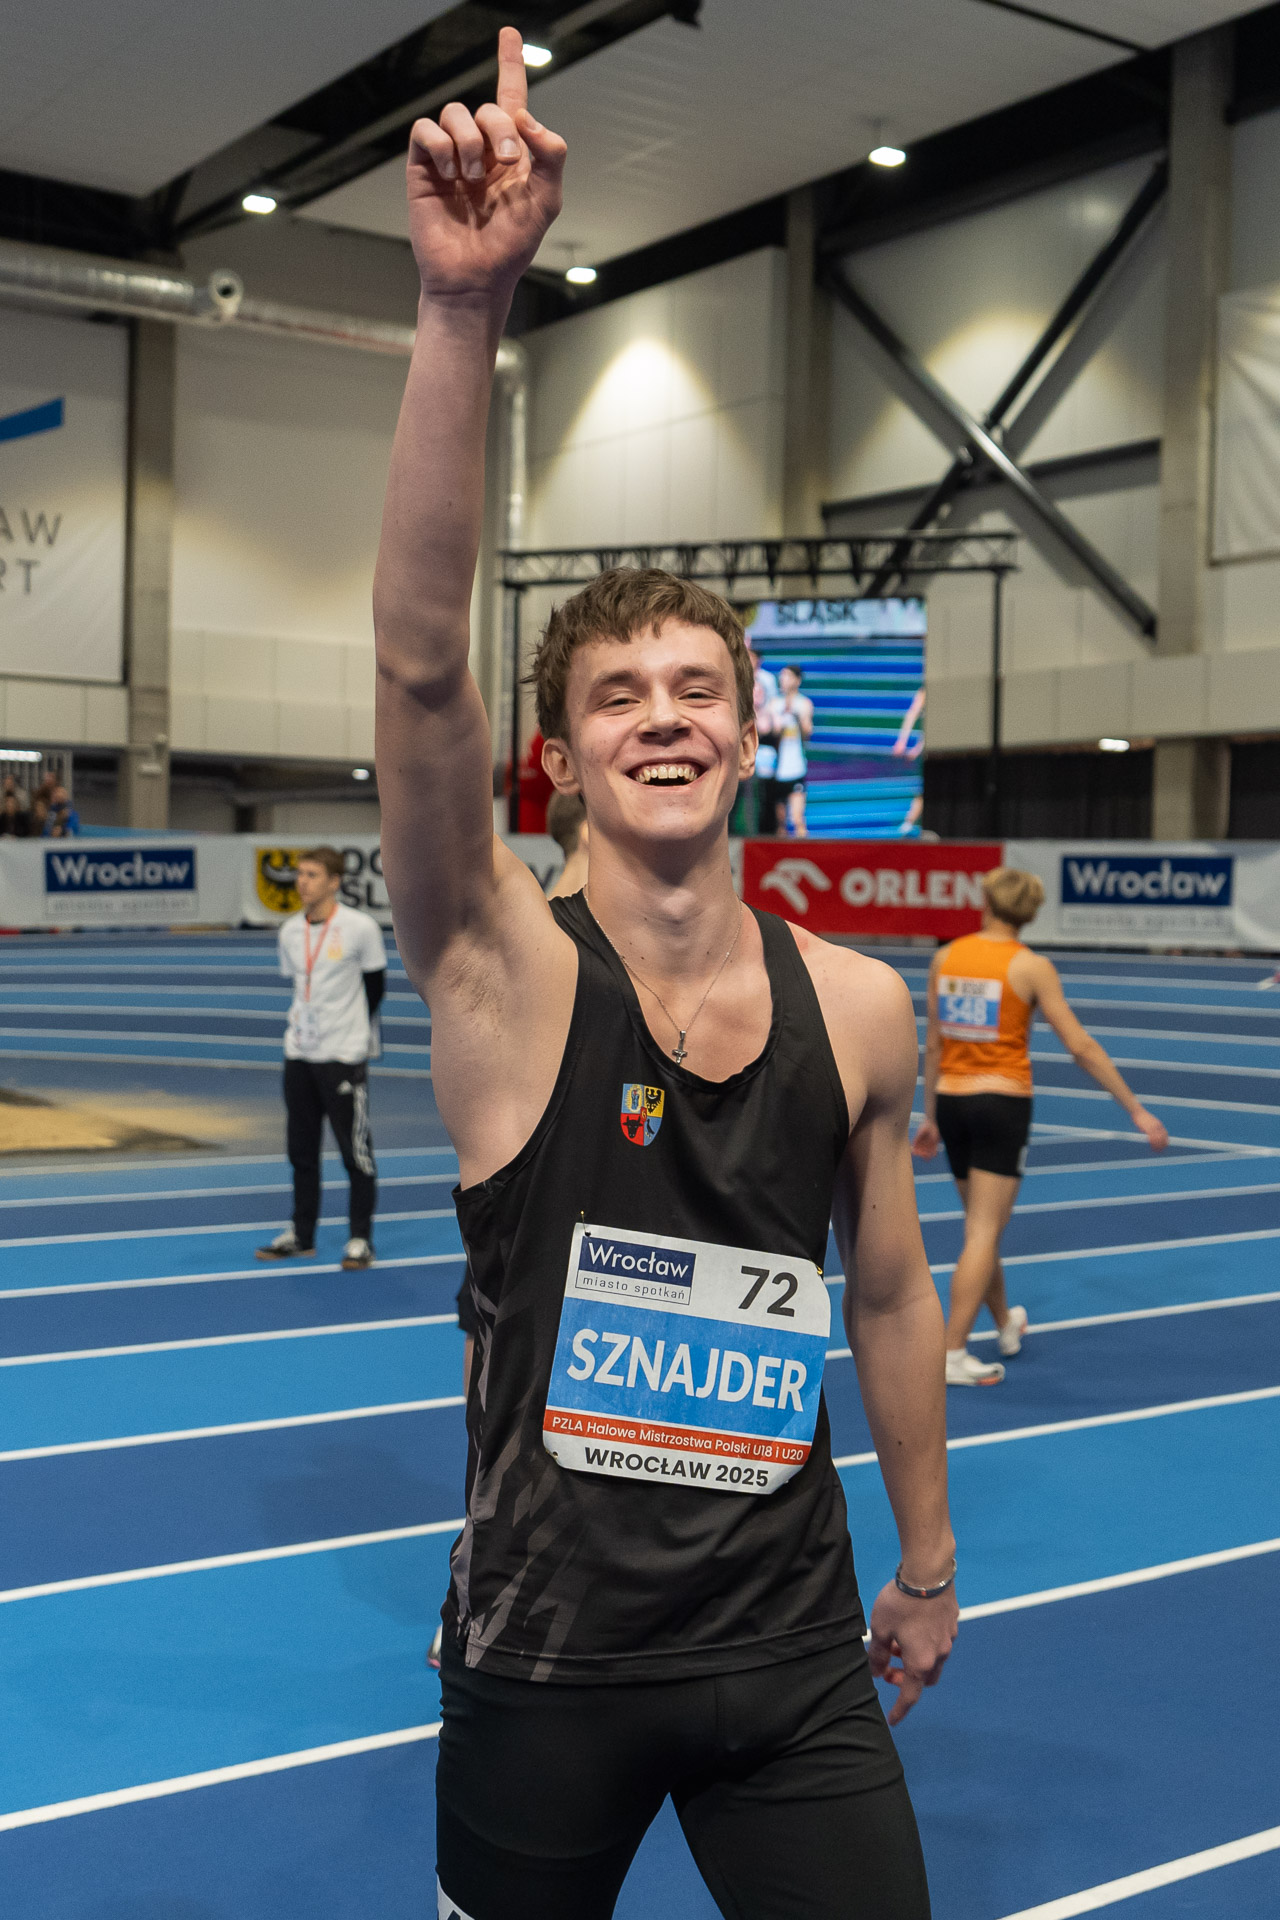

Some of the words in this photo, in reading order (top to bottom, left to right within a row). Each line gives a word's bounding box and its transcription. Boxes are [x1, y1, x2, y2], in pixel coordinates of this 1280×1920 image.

[840, 868, 986, 910] ORLEN
[588, 1242, 689, 1279] Wrocław
[582, 1276, 629, 1291] miasto
[634, 1284, 685, 1300] spotkań
[738, 1265, 799, 1317] 72
[566, 1328, 808, 1412] SZNAJDER
[552, 1416, 583, 1431] PZLA
[587, 1421, 637, 1439] Halowe
[639, 1429, 712, 1449] Mistrzostwa
[715, 1439, 751, 1455] Polski
[752, 1445, 773, 1457] U18
[775, 1446, 780, 1458] i
[781, 1448, 804, 1461] U20
[584, 1446, 711, 1480] WROCŁAW
[715, 1464, 769, 1487] 2025
